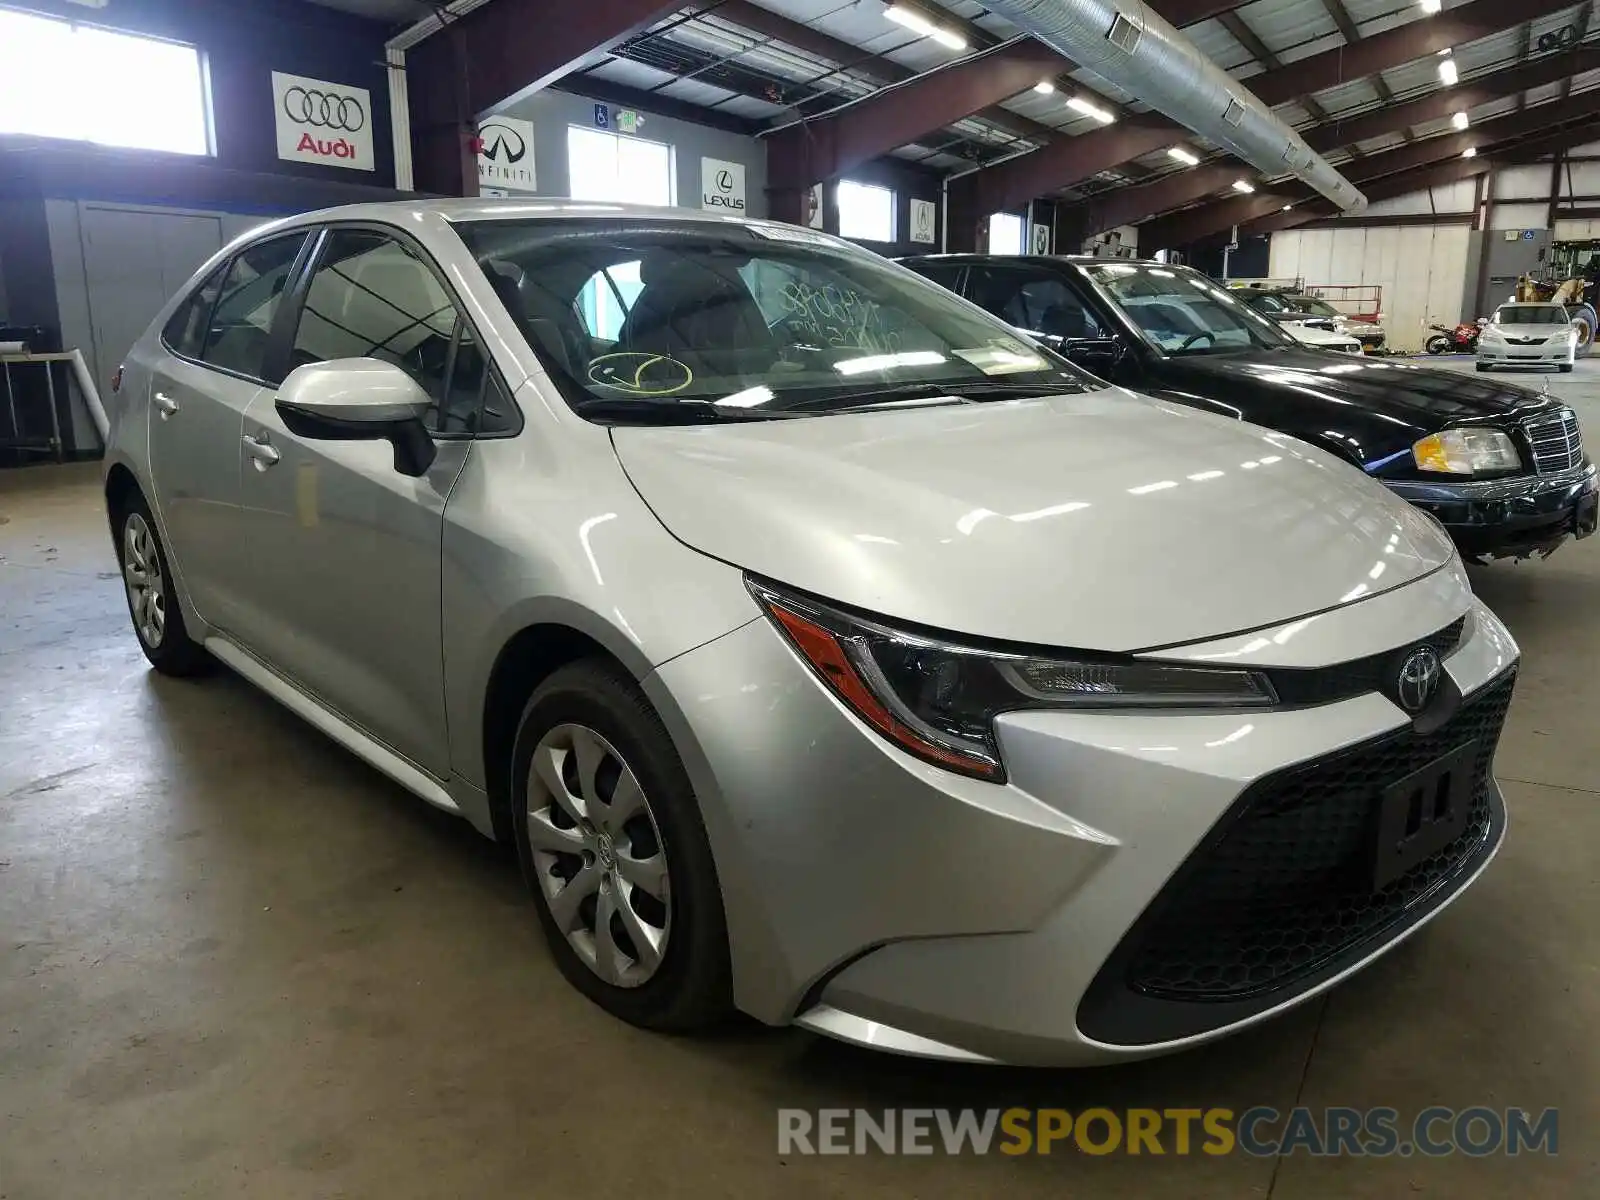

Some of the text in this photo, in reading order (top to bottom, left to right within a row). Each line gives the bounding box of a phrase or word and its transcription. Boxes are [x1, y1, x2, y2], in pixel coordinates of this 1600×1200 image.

[297, 132, 355, 159] Audi
[478, 164, 532, 182] NFINITI
[703, 193, 745, 210] LEXUS
